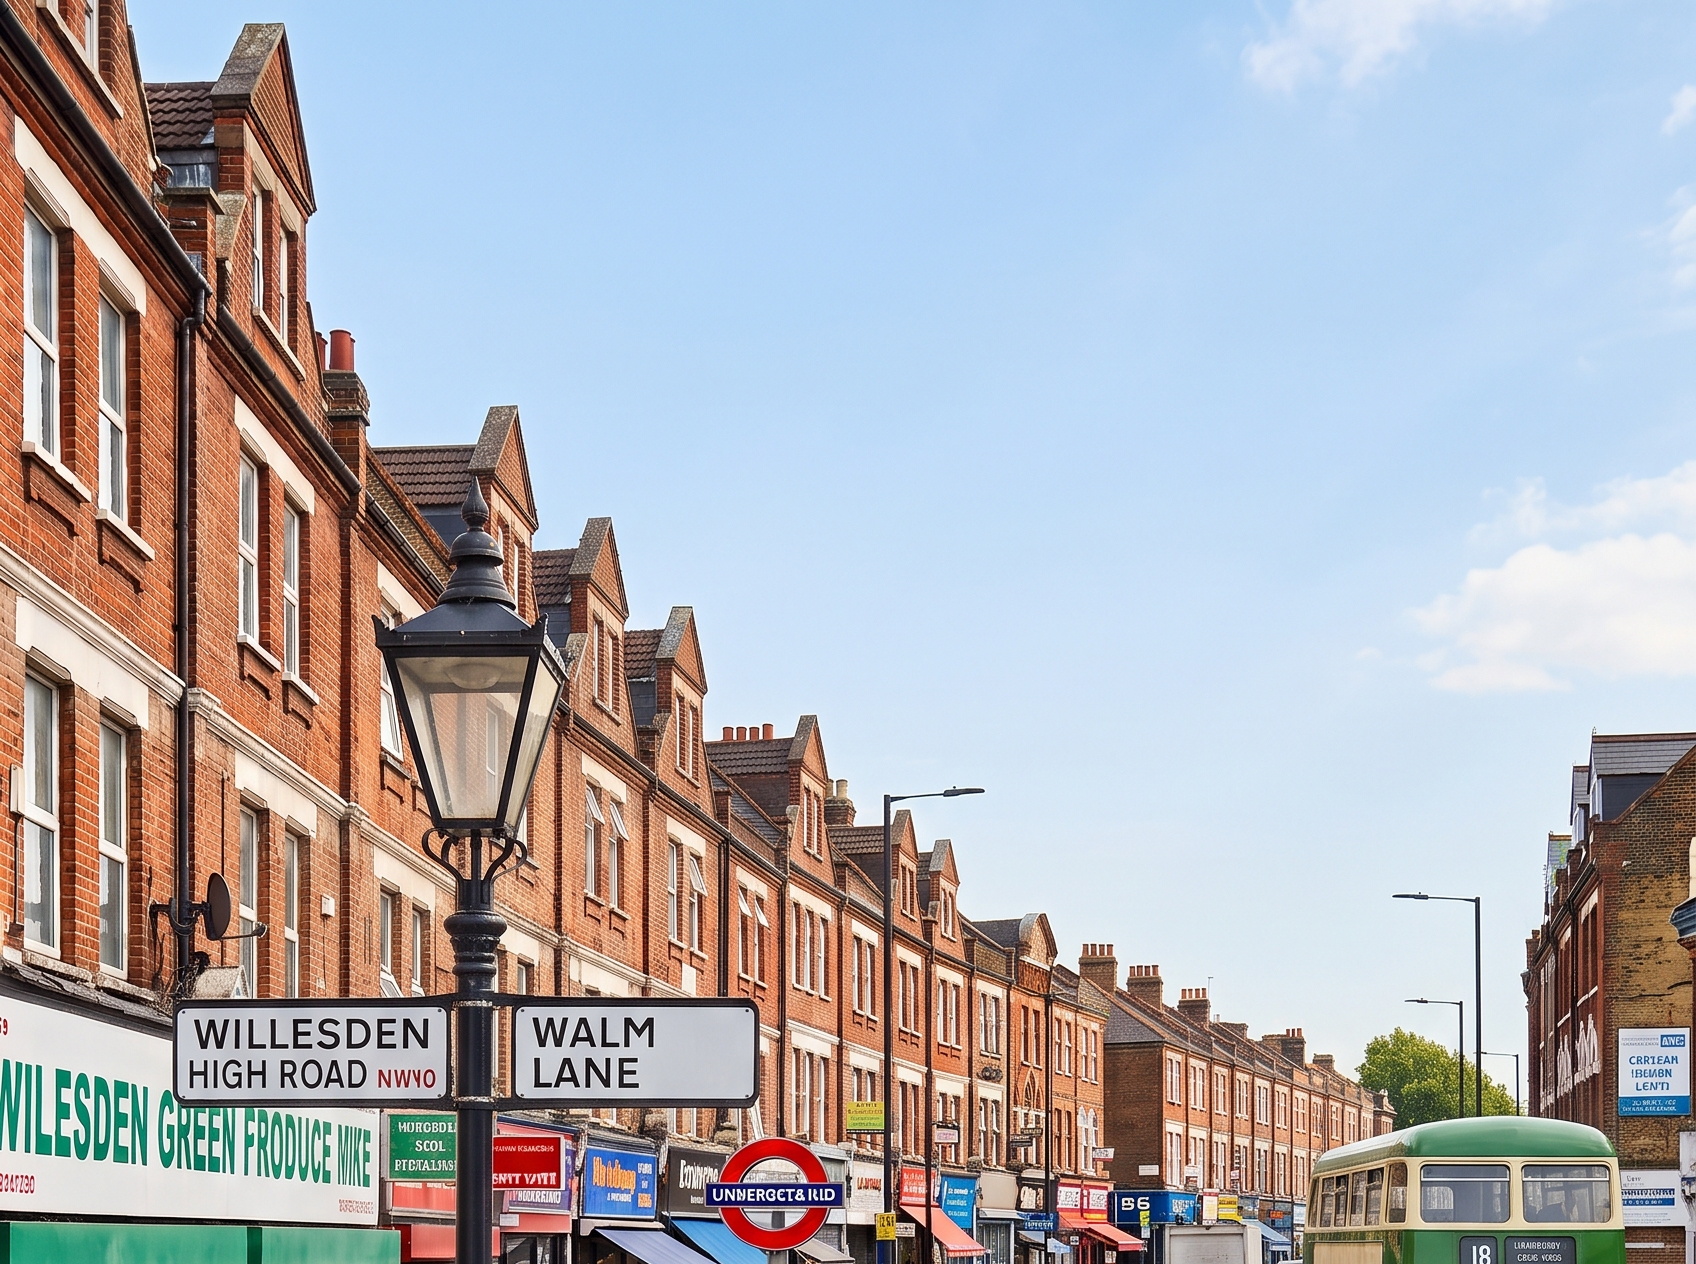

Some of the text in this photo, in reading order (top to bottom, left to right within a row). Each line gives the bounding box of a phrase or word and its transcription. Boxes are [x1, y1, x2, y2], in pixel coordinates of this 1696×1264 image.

[194, 1018, 429, 1049] WILLESDEN
[532, 1017, 655, 1048] WALM
[189, 1059, 267, 1089] HIGH
[280, 1059, 367, 1089] ROAD
[533, 1057, 640, 1088] LANE
[157, 1090, 236, 1175] GREEN
[337, 1123, 371, 1187] MIKE
